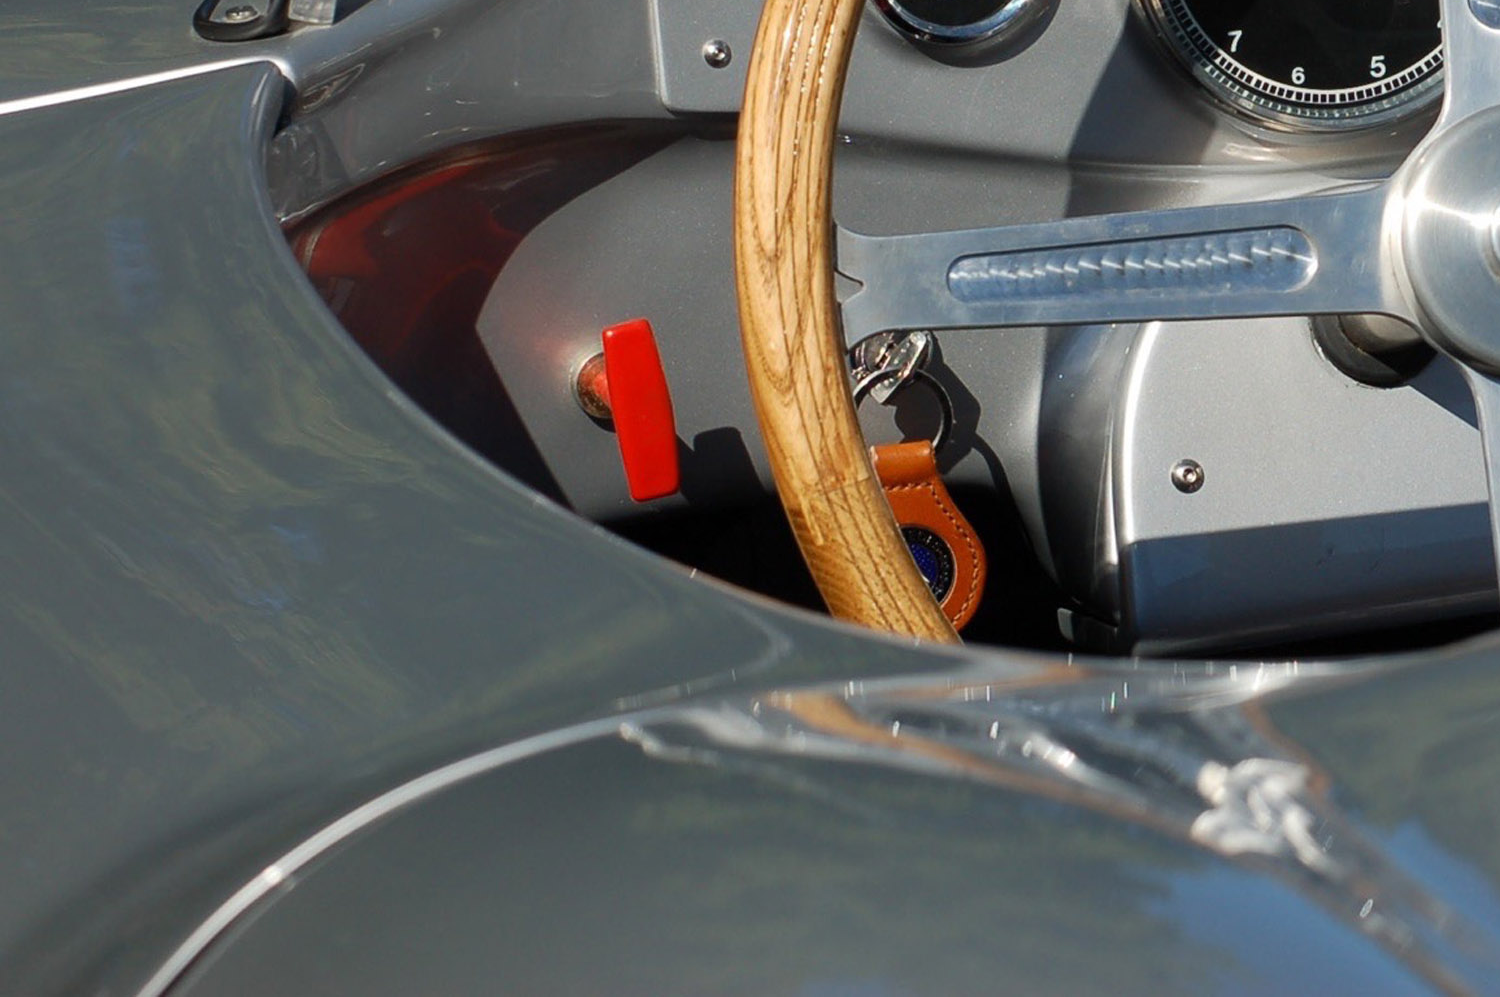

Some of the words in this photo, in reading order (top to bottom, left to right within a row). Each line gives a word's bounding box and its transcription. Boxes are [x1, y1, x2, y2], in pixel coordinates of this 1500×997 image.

[1227, 29, 1244, 53] 7
[1291, 67, 1306, 85] 6
[1369, 55, 1386, 78] 5
